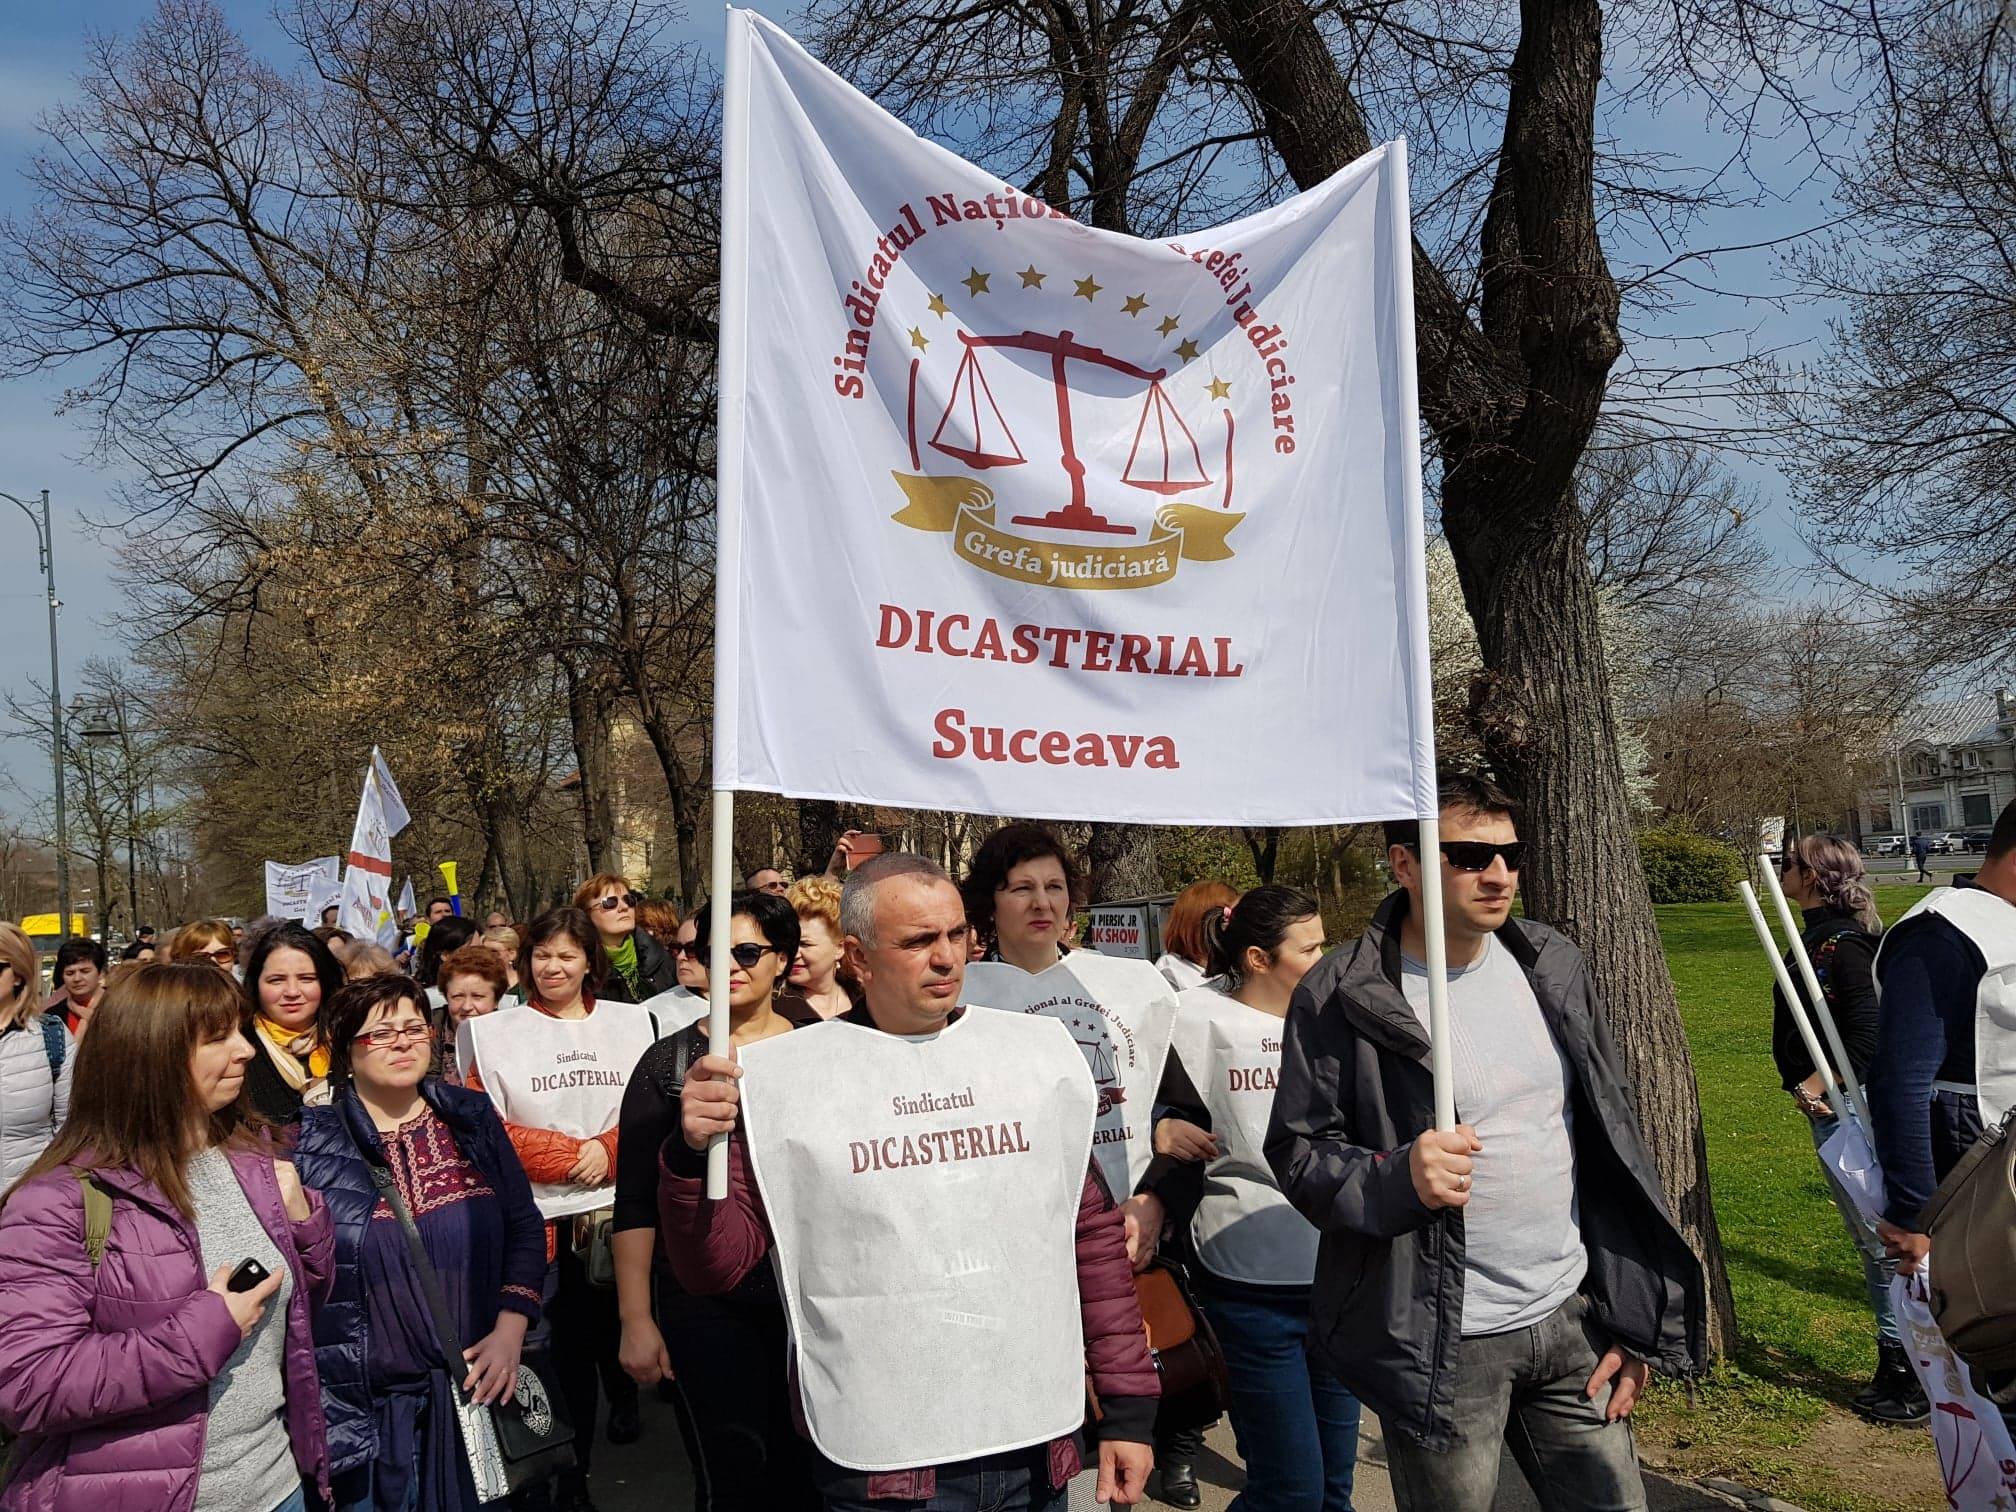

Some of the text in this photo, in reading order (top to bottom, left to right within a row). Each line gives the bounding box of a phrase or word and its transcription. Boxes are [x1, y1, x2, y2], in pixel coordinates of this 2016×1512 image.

[833, 204, 927, 400] Sindicatul
[1226, 282, 1297, 455] Judiciare
[964, 530, 1170, 584] Grefa judiciară
[875, 603, 1244, 678] DICASTERIAL
[932, 708, 1180, 770] Suceava
[1098, 914, 1125, 927] PIERSIC
[1127, 914, 1137, 927] JR
[1105, 928, 1139, 944] SHOW
[1061, 996, 1072, 1005] al
[1074, 998, 1112, 1018] Grefei
[1110, 1015, 1136, 1068] Judiciare
[1261, 1037, 1282, 1053] Sin
[556, 1050, 598, 1064] Sindicatul
[531, 1069, 625, 1093] DICASTERIAL
[1228, 1067, 1281, 1091] DICA
[892, 1086, 976, 1116] Sindicatul
[849, 1121, 1030, 1174] DICASTERIAL
